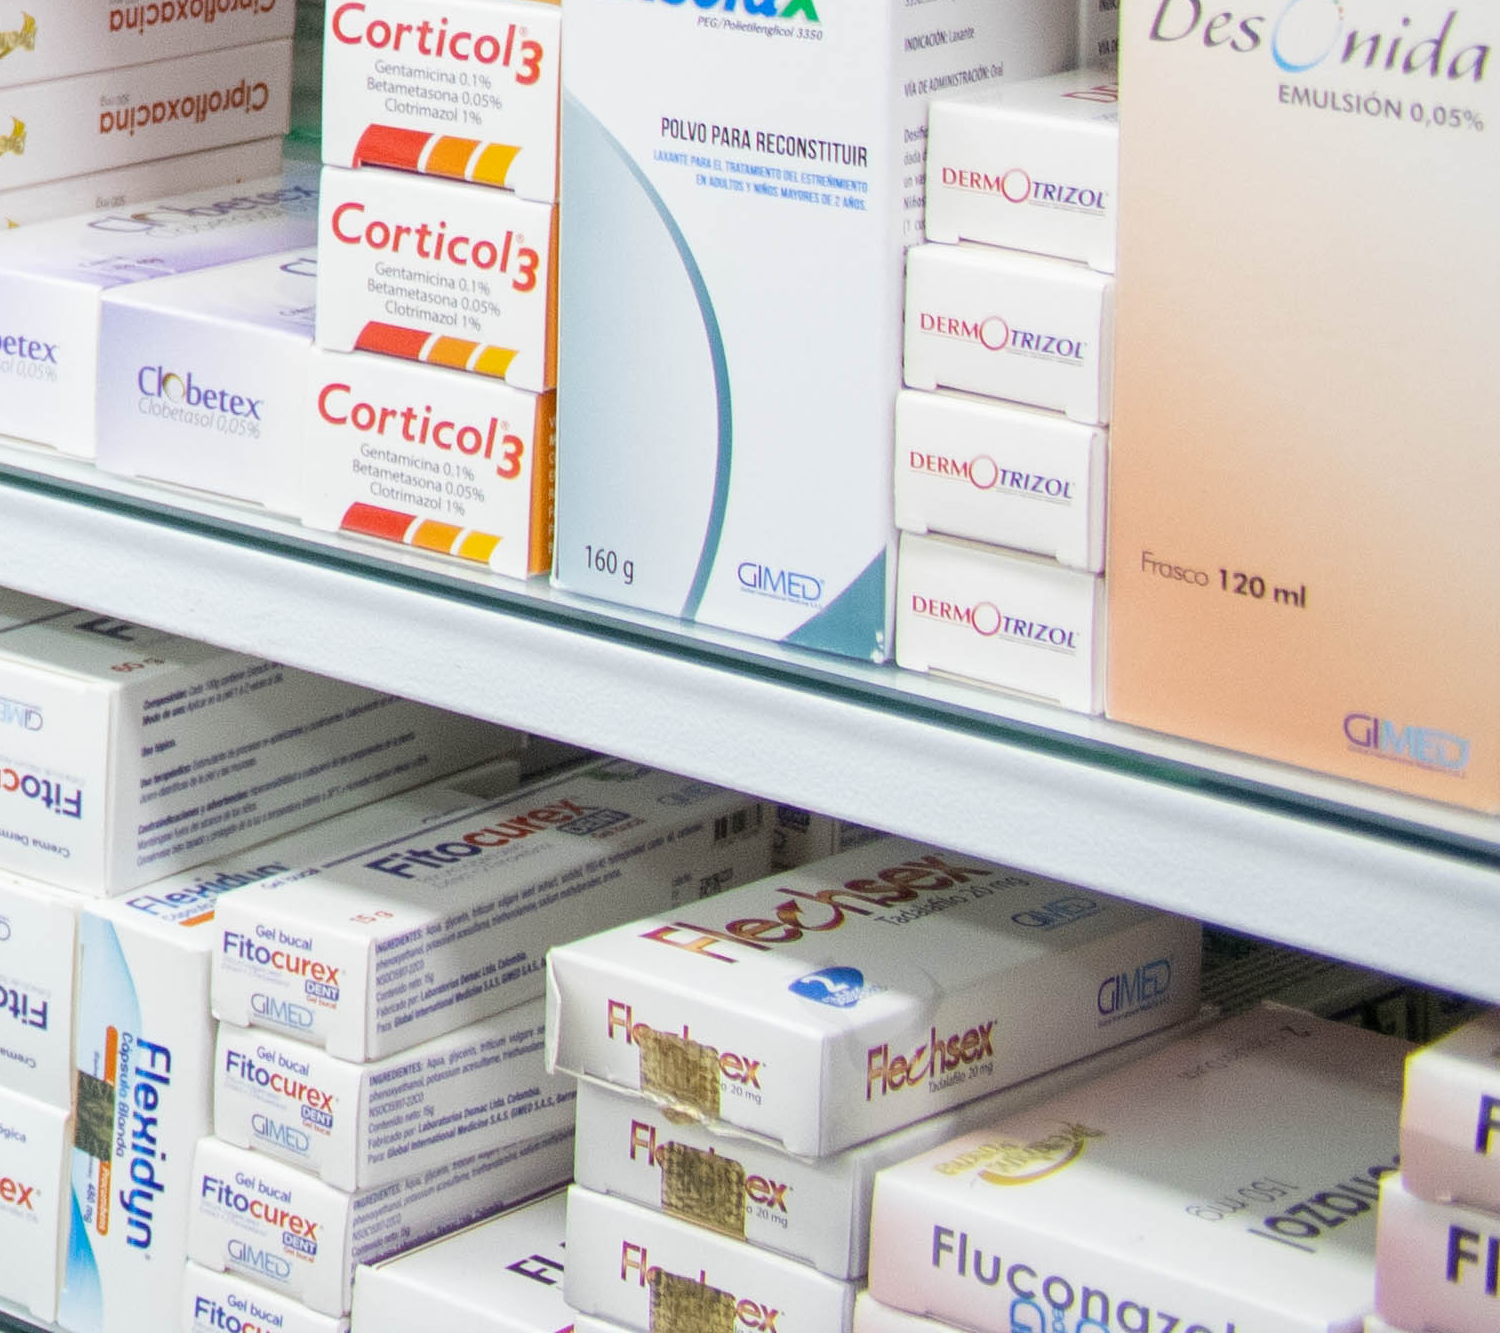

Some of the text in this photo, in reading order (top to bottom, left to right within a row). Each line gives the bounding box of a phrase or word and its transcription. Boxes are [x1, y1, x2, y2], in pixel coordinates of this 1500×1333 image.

[796, 27, 823, 41] 3350
[365, 77, 503, 111] Betametasona 0.05%
[373, 57, 492, 90] Gentamicina 0.1%
[383, 97, 482, 125] Clotrimazol 1%
[1278, 83, 1485, 132] EMULSIÓN 0,05%
[661, 117, 868, 167] POLVO PARA RECONSTITUIR
[653, 149, 688, 166] LAXANTE
[691, 156, 711, 169] PARA
[714, 159, 723, 171] EL
[784, 169, 798, 182] DEL
[584, 544, 635, 586] 160 g
[738, 561, 822, 600] GIMED
[1141, 550, 1307, 610] Frasco 120 ml
[1343, 714, 1471, 772] GIMED
[222, 930, 340, 986] Fitocurex
[254, 924, 313, 952] Gel bucal
[1097, 958, 1172, 1018] GIMED
[250, 992, 315, 1028] GIMED
[866, 1024, 996, 1102] Flechsex
[126, 1037, 171, 1251] Flexidyn
